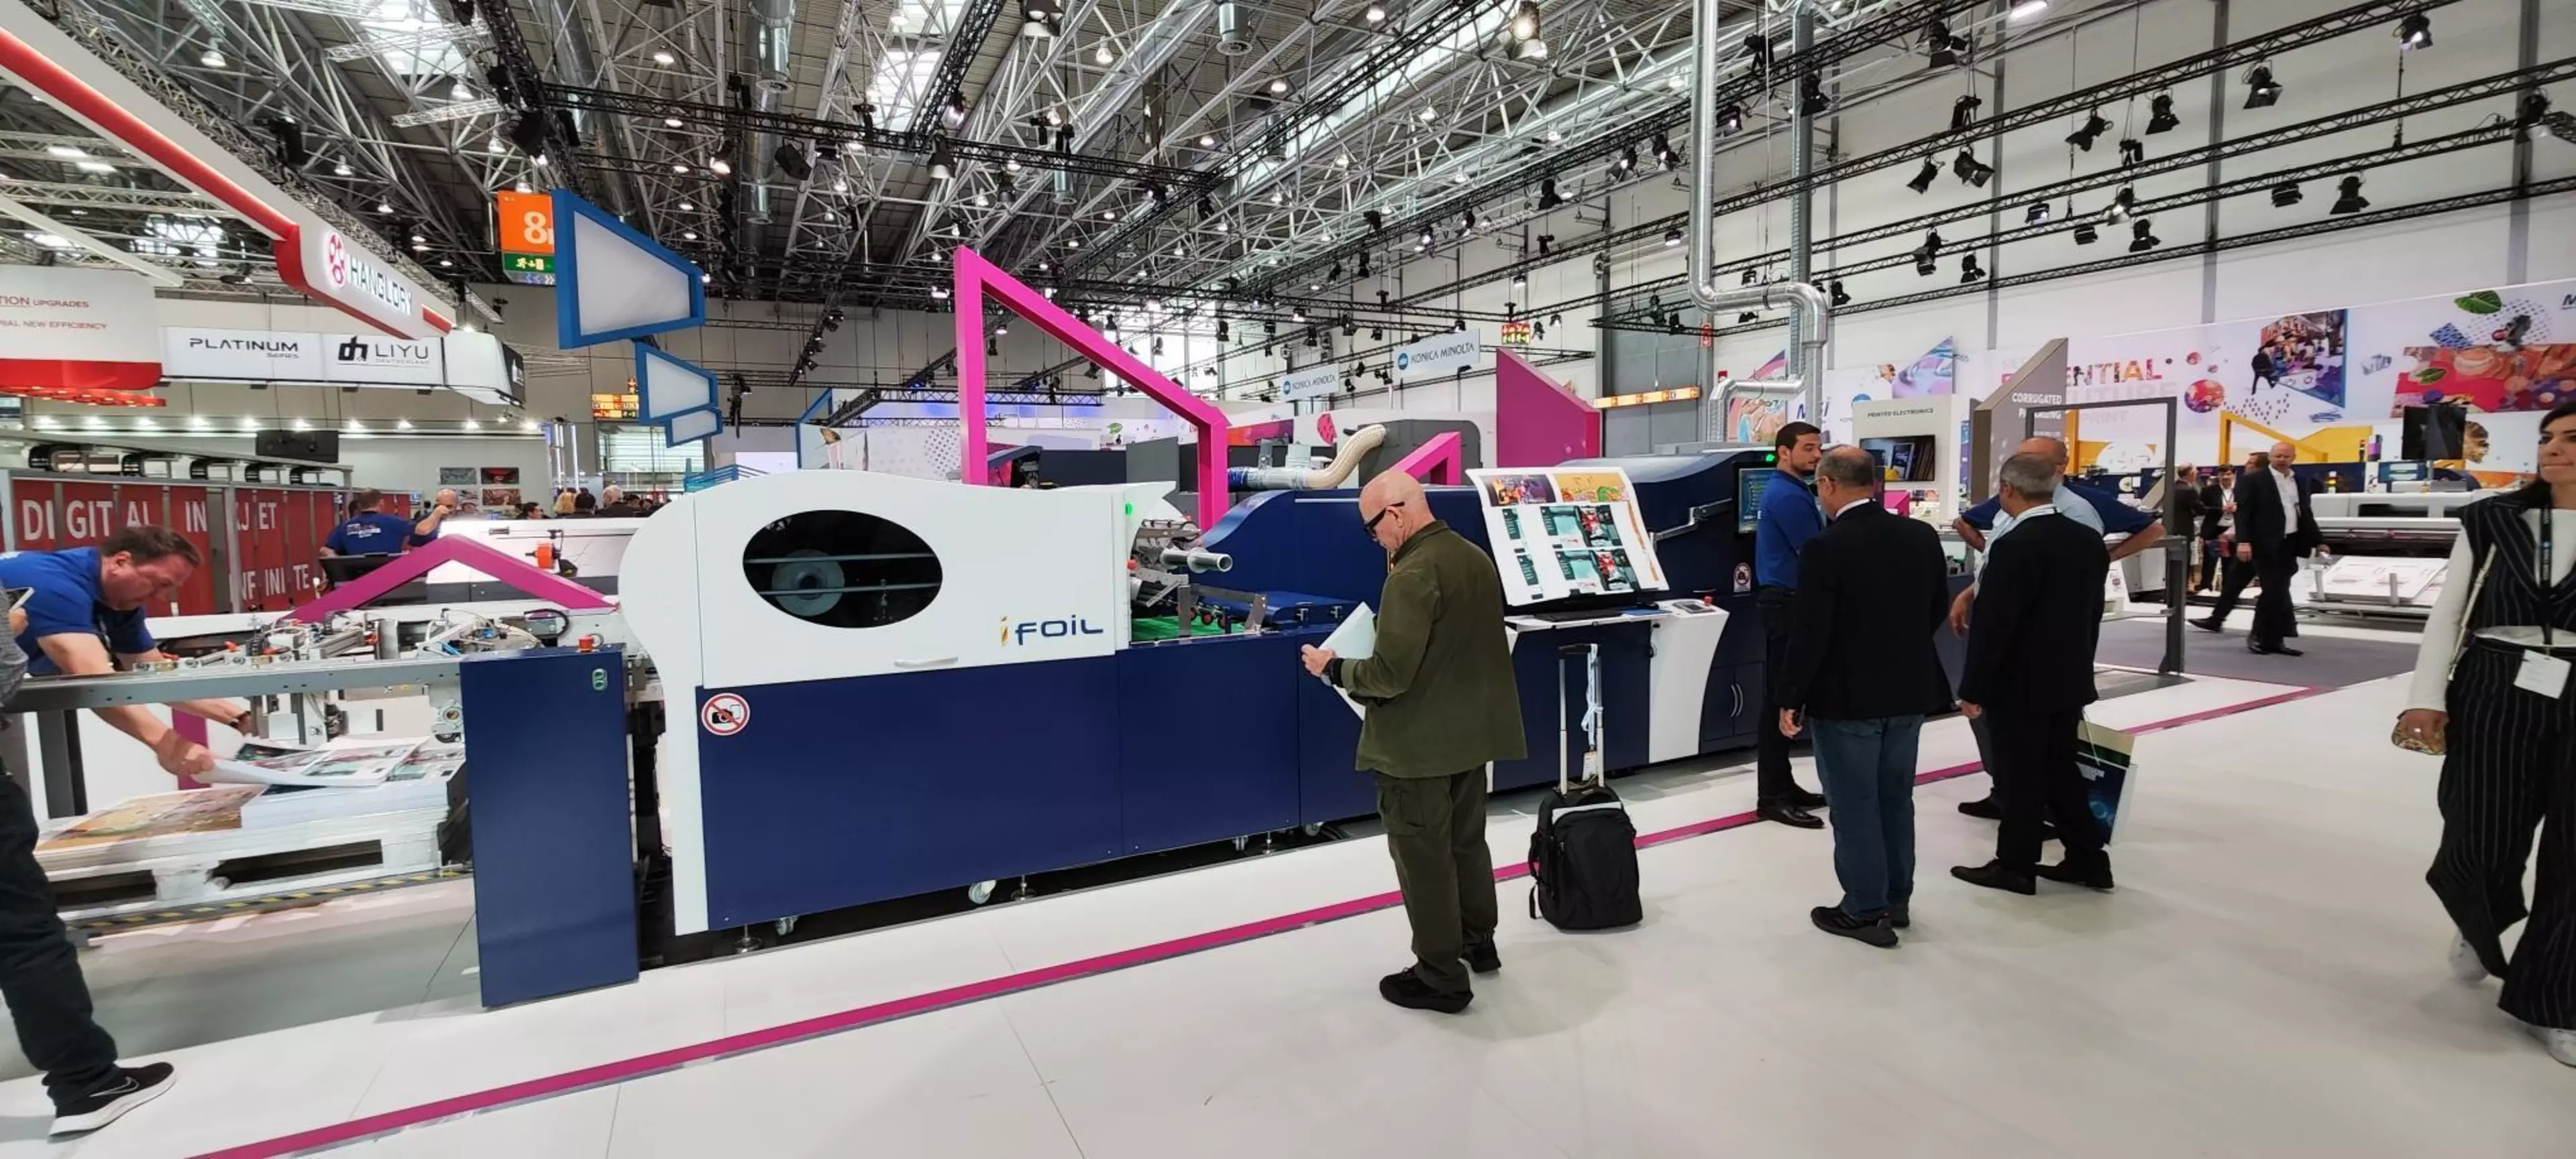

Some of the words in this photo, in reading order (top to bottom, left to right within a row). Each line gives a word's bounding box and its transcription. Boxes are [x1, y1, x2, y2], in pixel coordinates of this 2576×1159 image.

[348, 254, 413, 315] HANGLORY
[33, 299, 89, 309] UPGRADES
[49, 321, 107, 330] EFFICIENCY
[190, 337, 298, 352] PLATINUM
[375, 343, 429, 360] LIYU
[1411, 351, 1439, 365] KONICA
[1440, 343, 1474, 358] MINOLTA
[2012, 392, 2062, 404] CORRUGATED
[1892, 408, 1934, 417] ELECTRONICS
